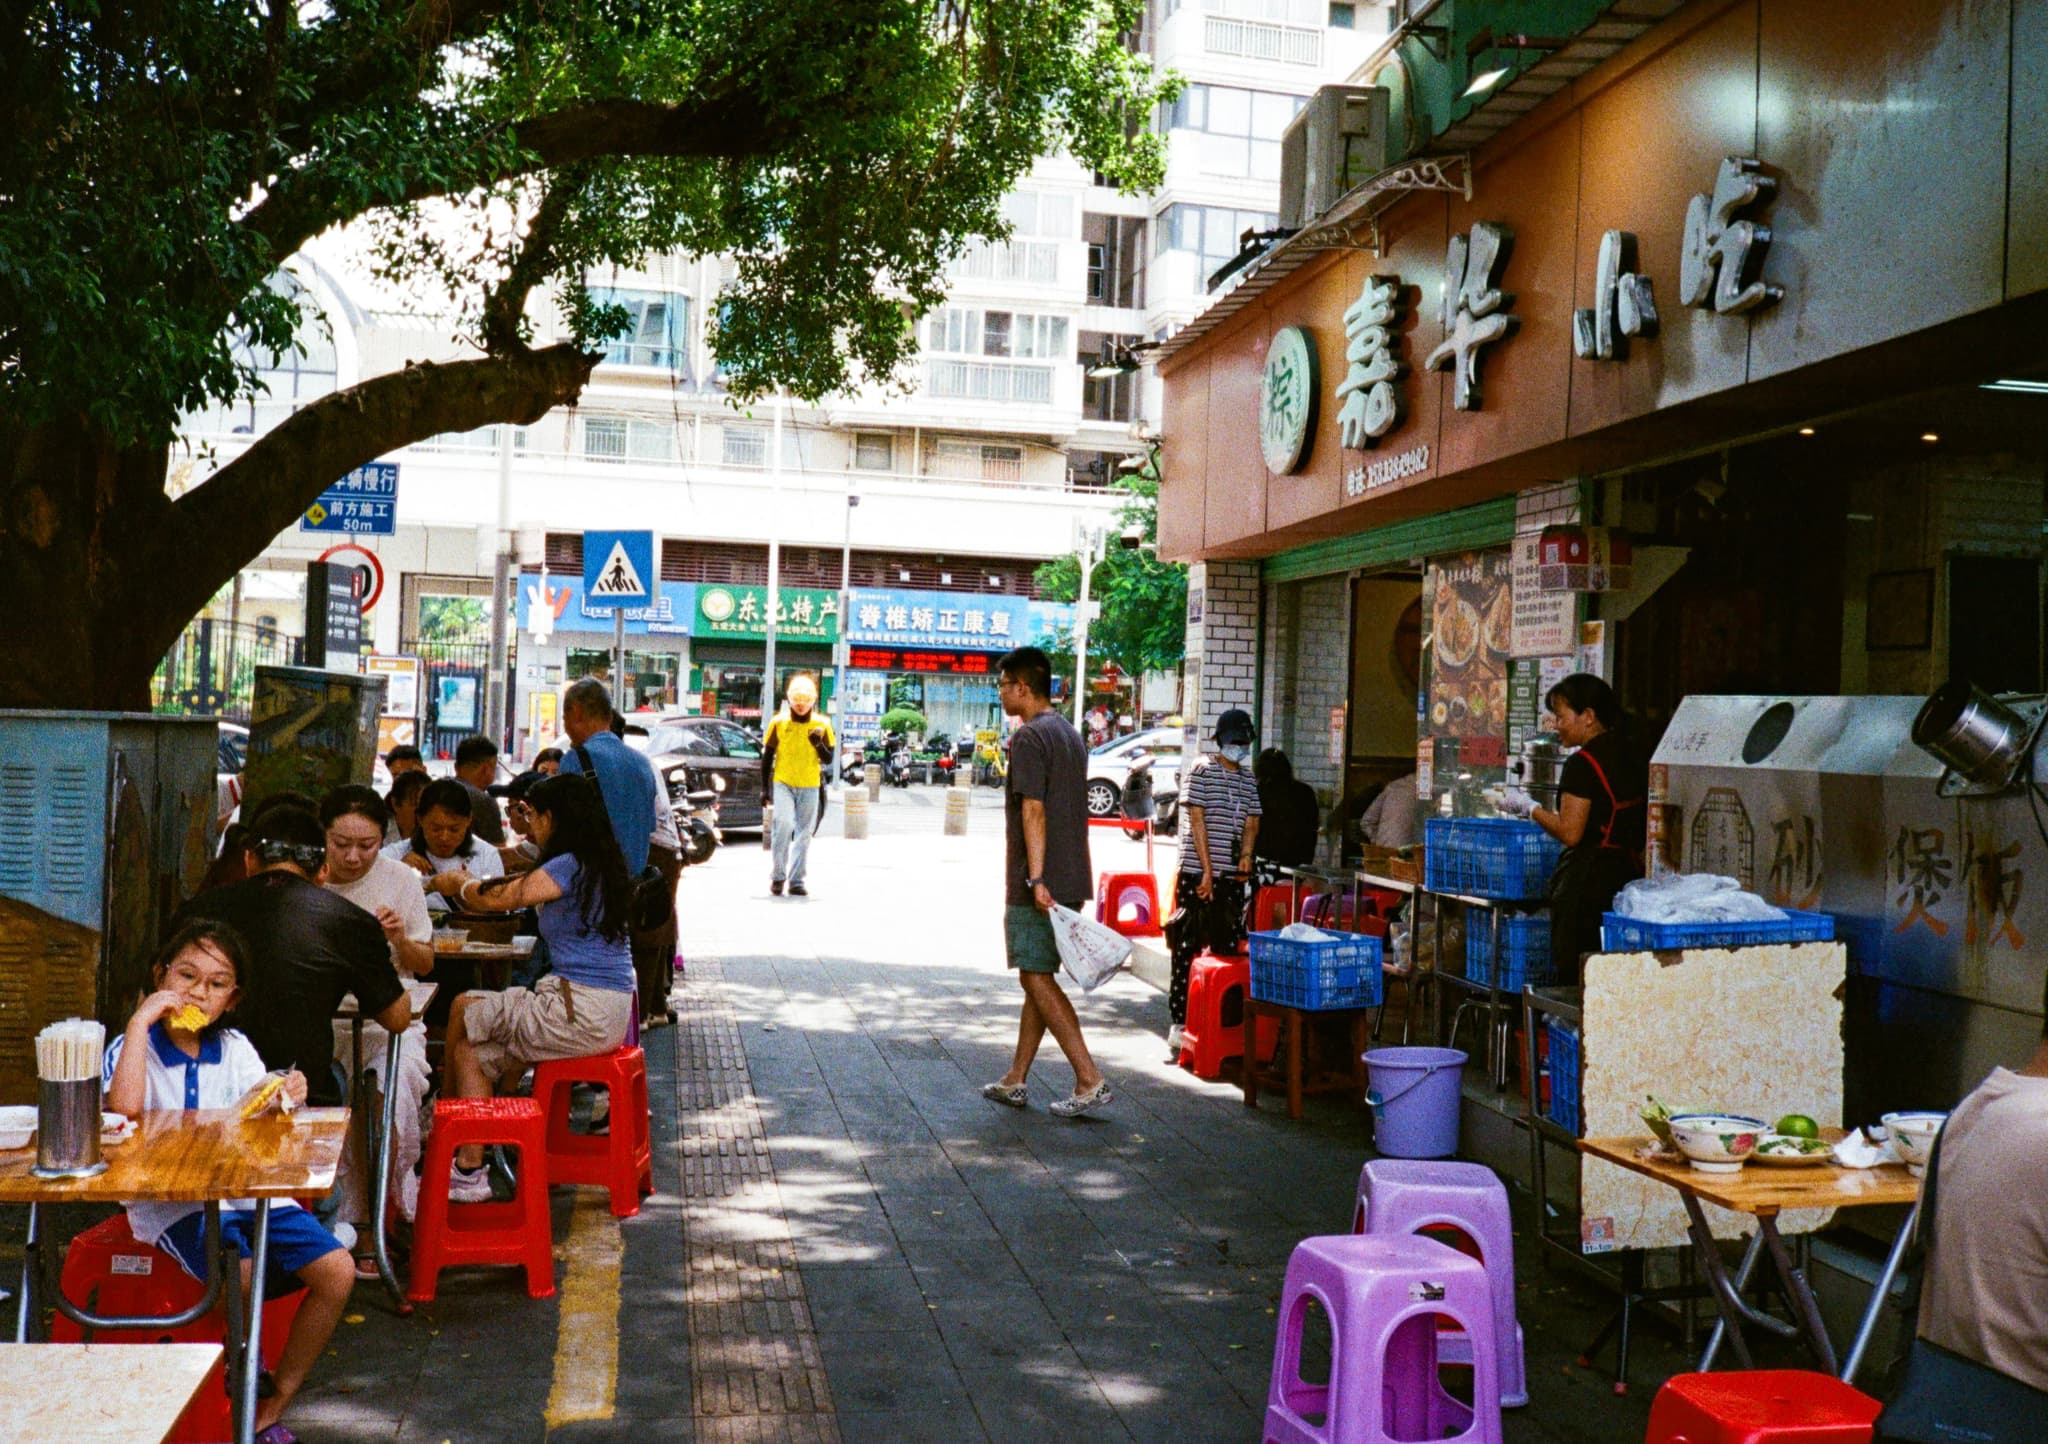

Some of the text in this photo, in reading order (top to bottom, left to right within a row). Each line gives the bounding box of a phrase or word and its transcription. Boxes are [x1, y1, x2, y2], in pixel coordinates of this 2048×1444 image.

[330, 500, 389, 518] 前方施工
[343, 518, 373, 531] 50m
[738, 592, 838, 626] 东北特产
[859, 604, 1010, 636] 脊椎矫正康复
